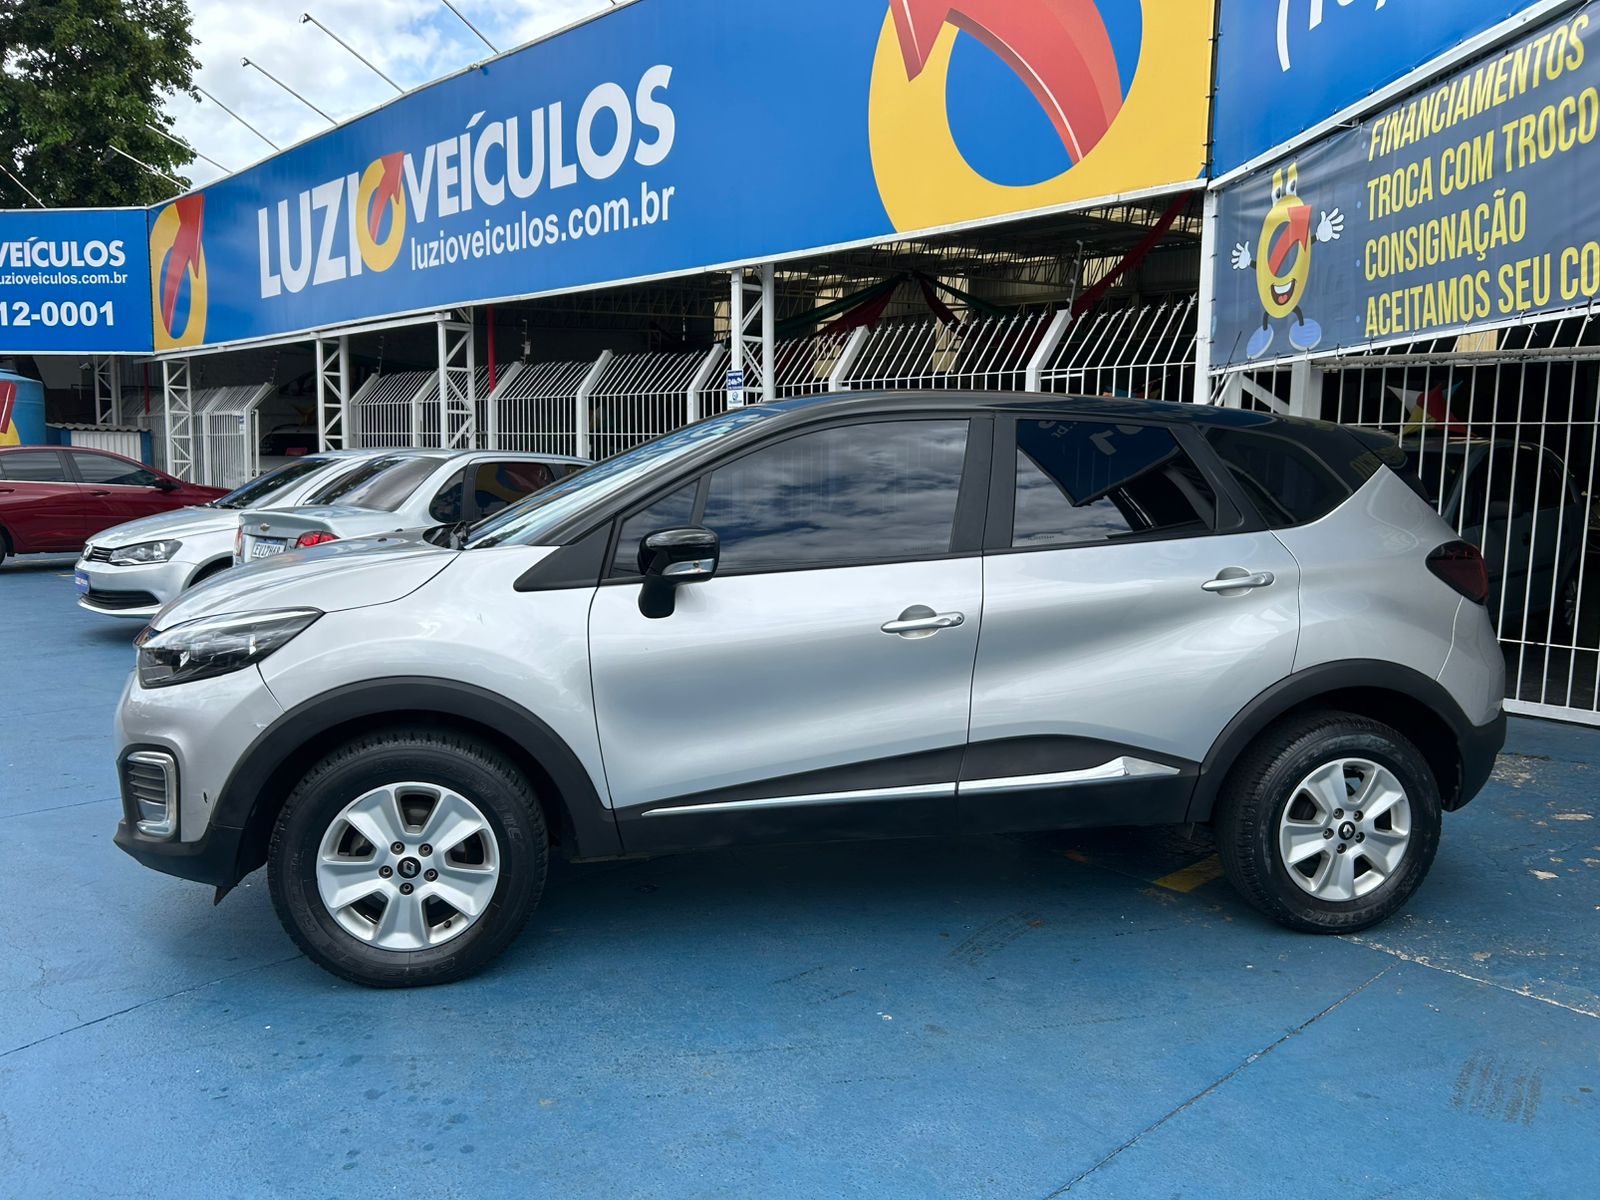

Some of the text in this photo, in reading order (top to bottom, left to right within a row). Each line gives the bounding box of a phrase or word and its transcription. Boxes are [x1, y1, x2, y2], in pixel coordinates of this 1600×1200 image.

[403, 64, 676, 224] VEÍCULOS
[1368, 14, 1589, 162] FINANCIAMENTOS
[1367, 86, 1599, 221] TROCA COM TROCO
[411, 182, 676, 271] luzioveiculos.com.br
[1365, 188, 1527, 281] CONSIGNAÇÃO
[1365, 269, 1490, 338] ACEITAMOS
[1498, 253, 1550, 314] SEU
